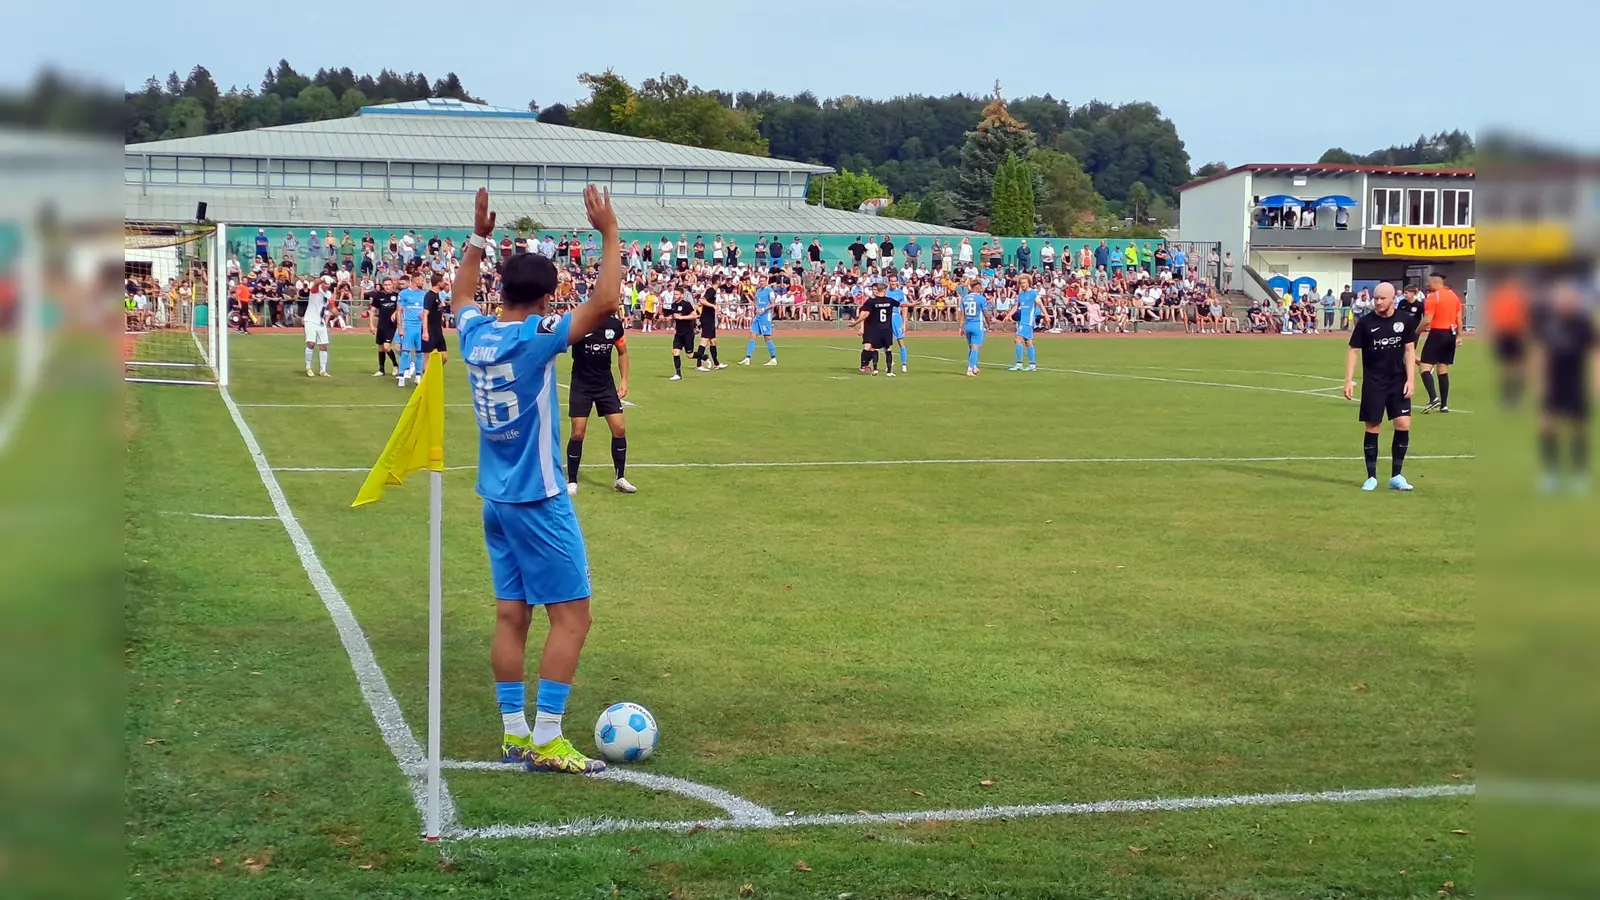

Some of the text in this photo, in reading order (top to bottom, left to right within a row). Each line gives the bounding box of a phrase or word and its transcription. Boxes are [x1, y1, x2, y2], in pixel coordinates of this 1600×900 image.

[1385, 231, 1404, 248] FC
[879, 308, 887, 323] 6
[963, 301, 977, 316] 28
[1373, 336, 1402, 346] HOSP
